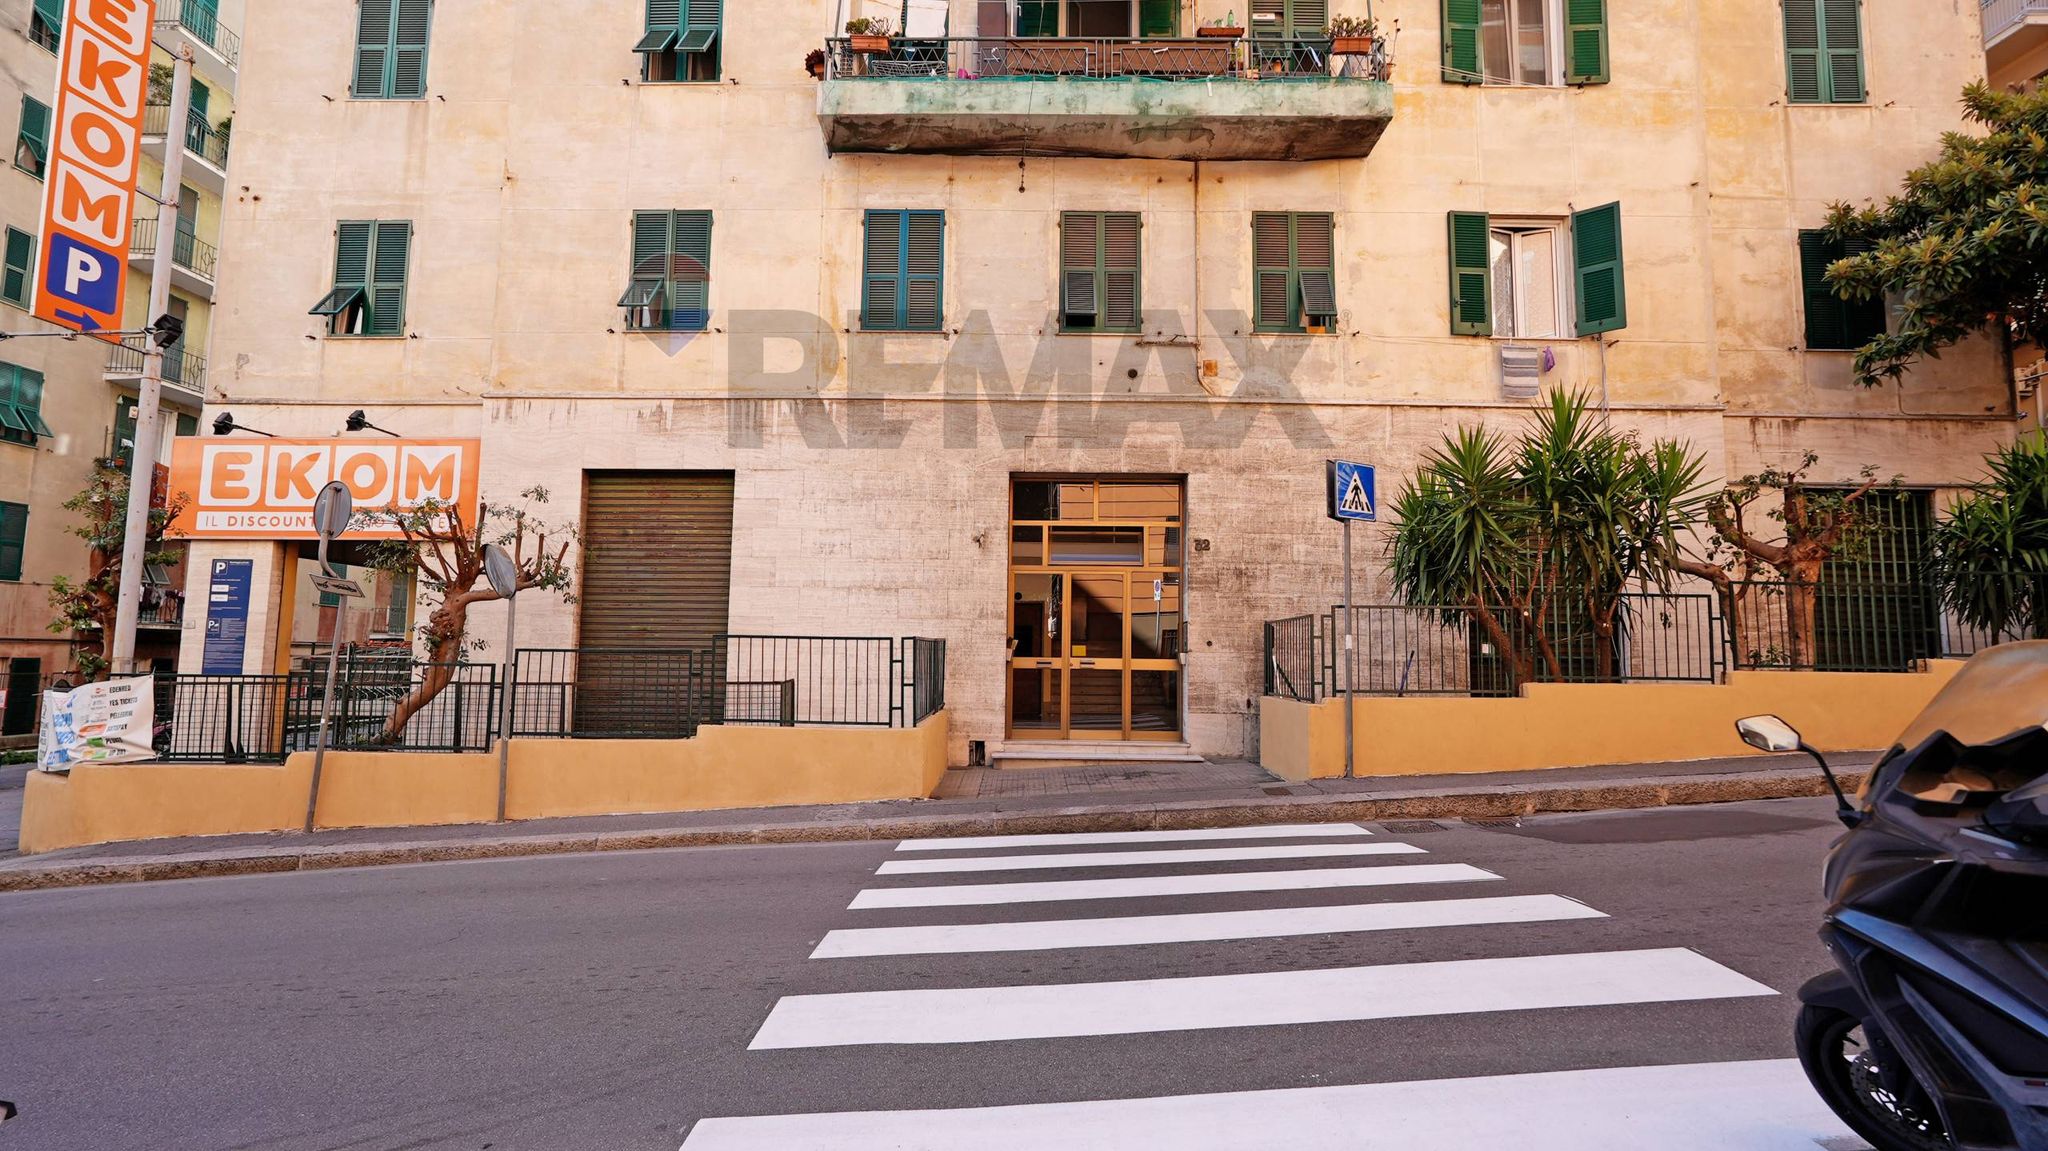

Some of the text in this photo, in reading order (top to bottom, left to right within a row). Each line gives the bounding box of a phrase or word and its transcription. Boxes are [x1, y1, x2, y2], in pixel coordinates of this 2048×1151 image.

[61, 0, 136, 239] EKOM
[65, 247, 102, 294] P
[210, 451, 455, 500] EKOM
[205, 516, 218, 527] IL
[215, 562, 226, 574] P
